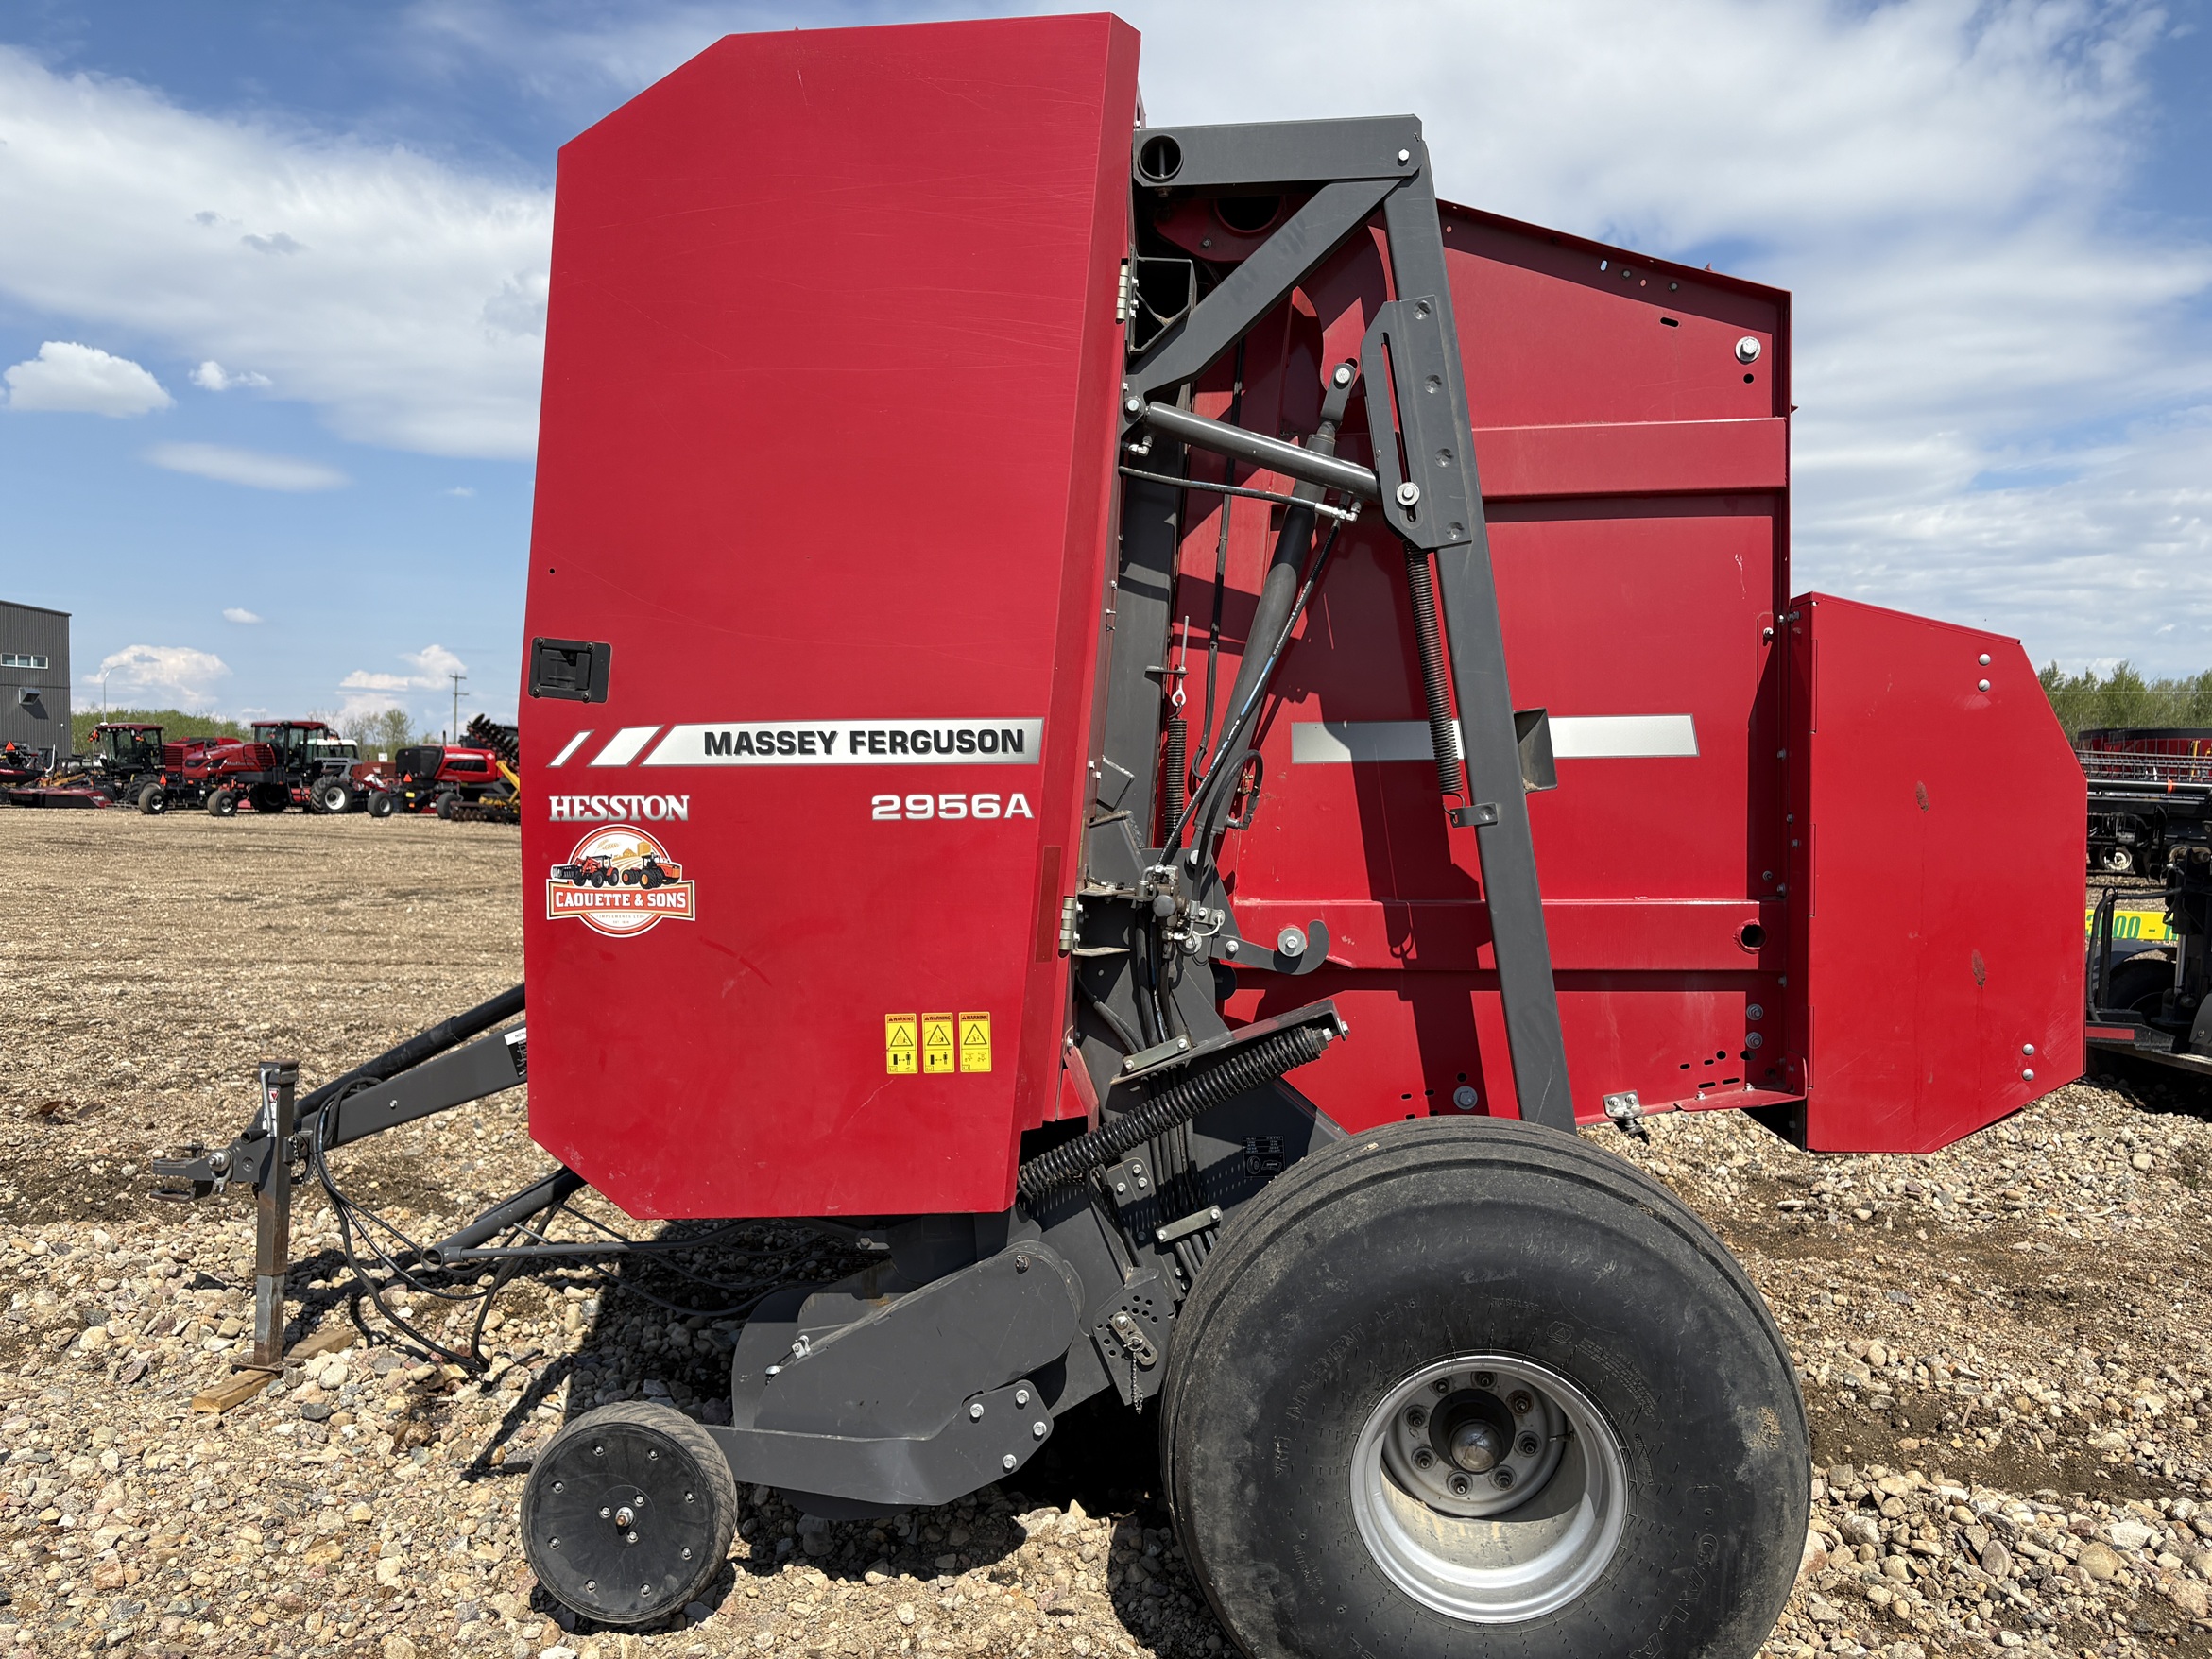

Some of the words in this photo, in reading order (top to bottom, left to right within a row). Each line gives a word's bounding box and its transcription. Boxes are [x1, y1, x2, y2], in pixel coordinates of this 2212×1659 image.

[703, 729, 838, 757] MASSEY
[849, 727, 1025, 755] FERGUSON
[549, 795, 690, 821] HESSTON
[871, 793, 1035, 820] 2956A
[555, 891, 630, 908] CAOUETTE
[634, 893, 644, 907] &
[647, 892, 687, 908] SONS
